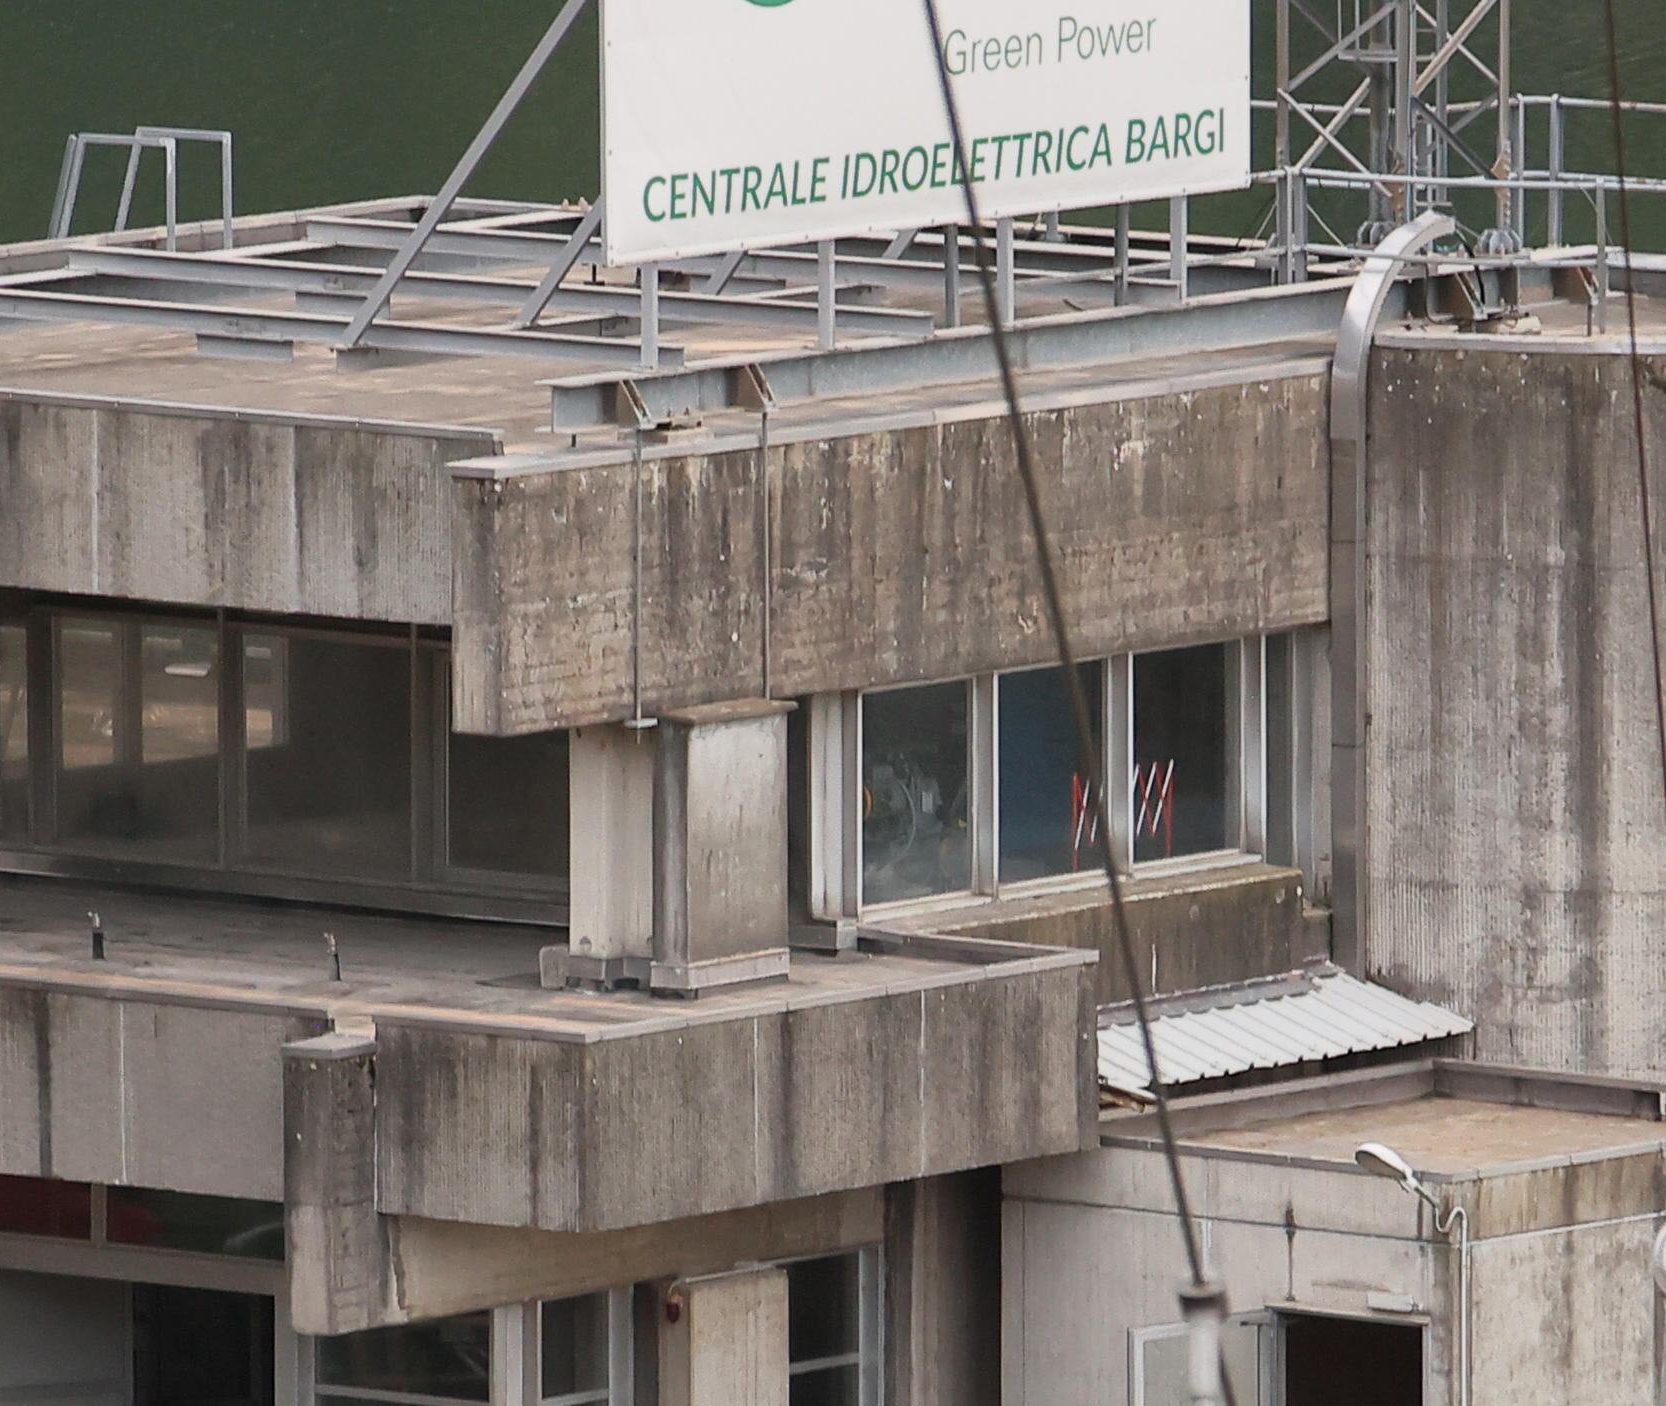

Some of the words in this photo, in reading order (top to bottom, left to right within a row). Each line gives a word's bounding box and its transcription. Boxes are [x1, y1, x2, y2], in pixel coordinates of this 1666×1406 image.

[943, 29, 1043, 76] Green
[1057, 16, 1157, 63] Power
[643, 156, 830, 223] CENTRALE
[841, 122, 1113, 200] IDROELETTRICA
[1124, 107, 1225, 164] BARGI
